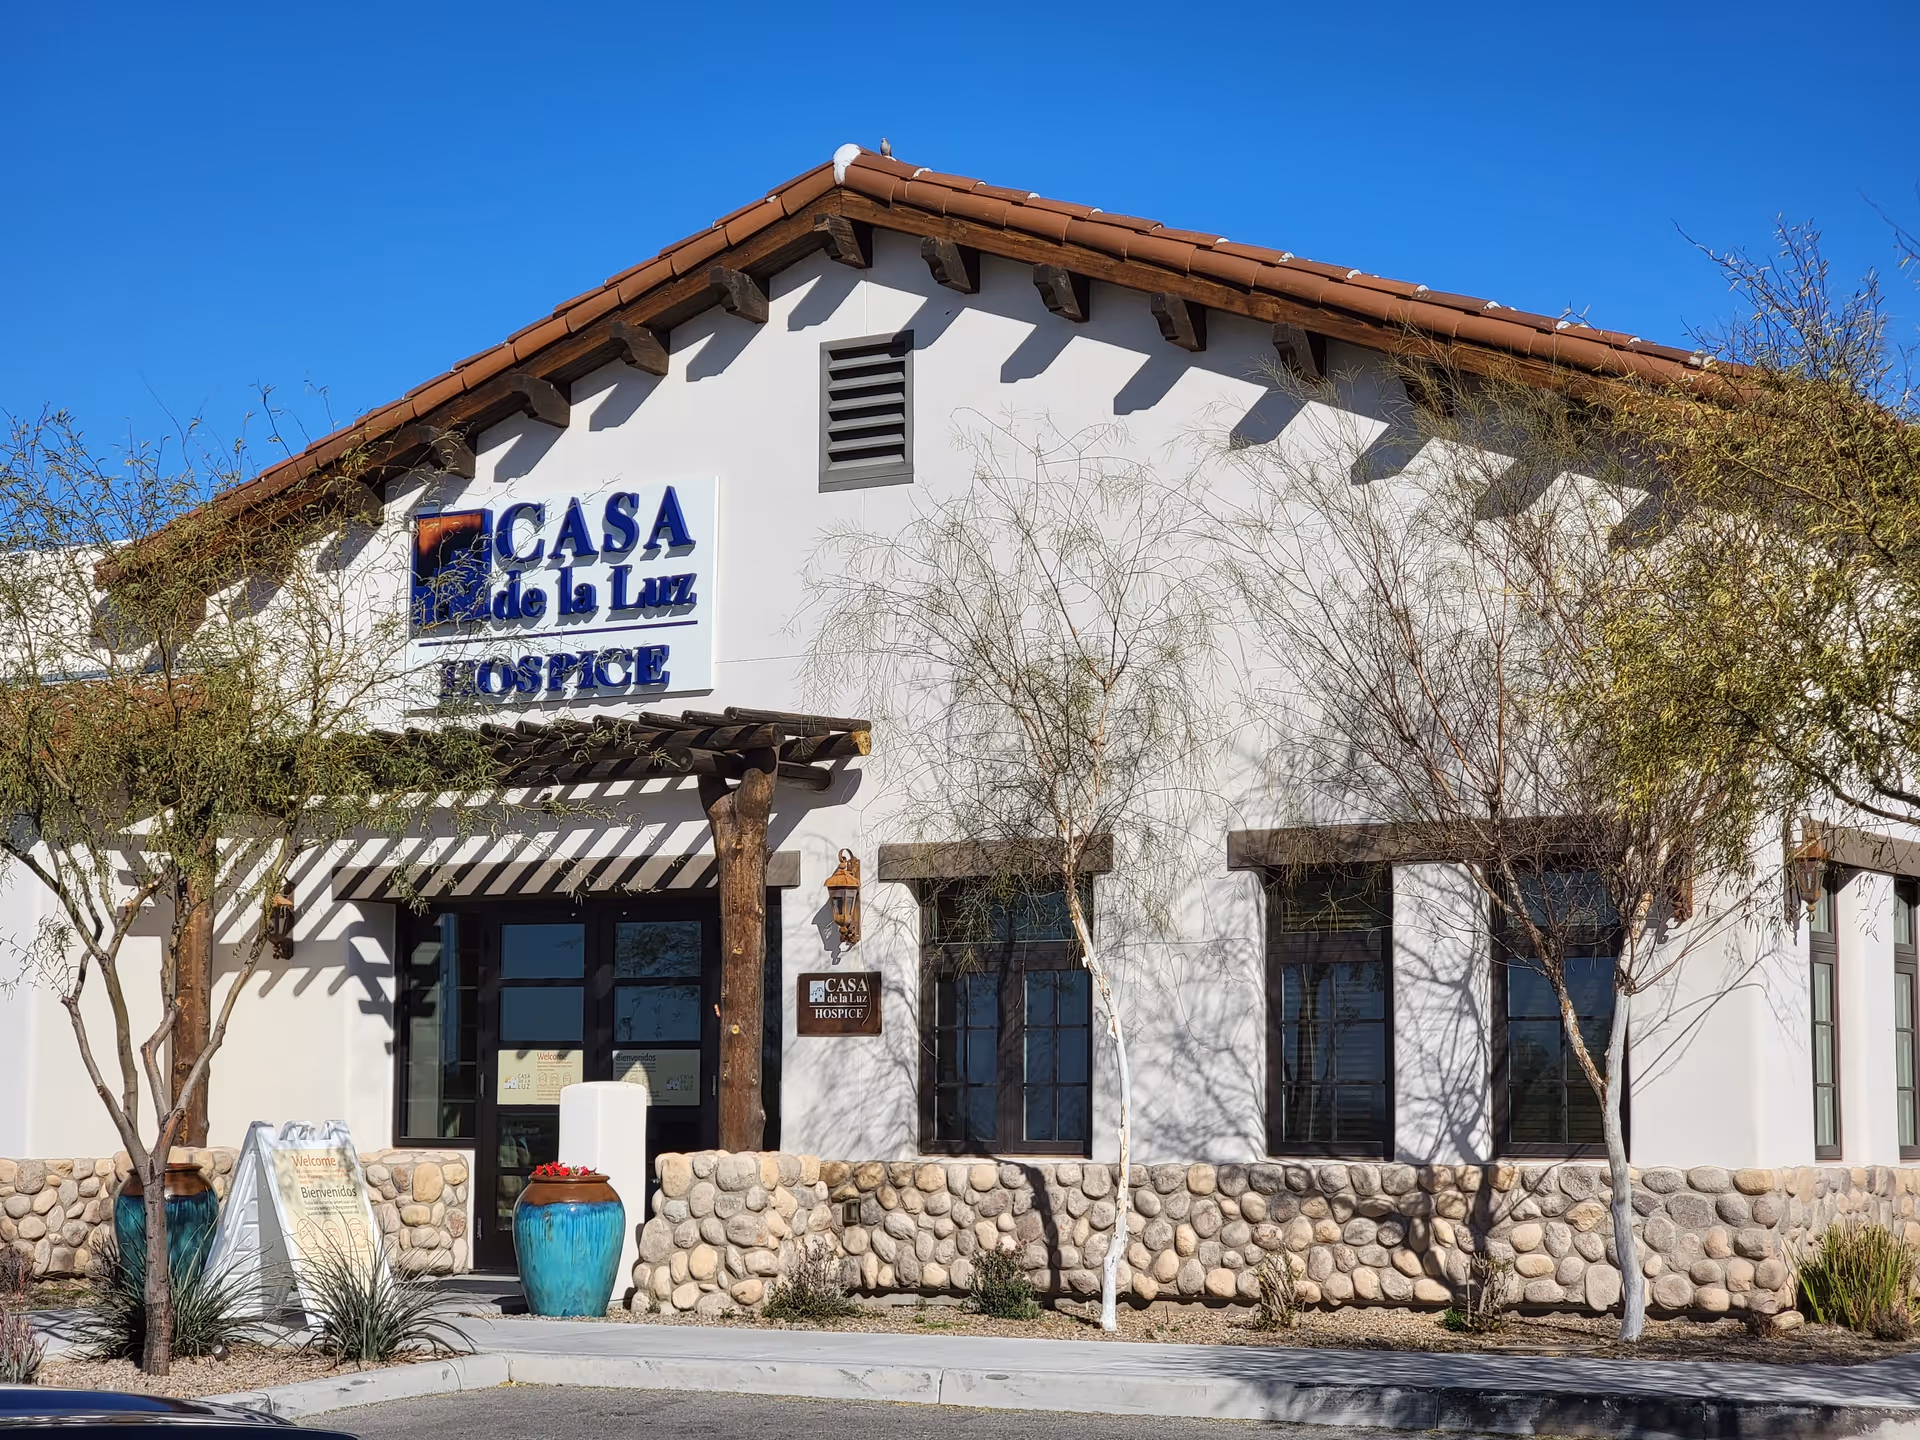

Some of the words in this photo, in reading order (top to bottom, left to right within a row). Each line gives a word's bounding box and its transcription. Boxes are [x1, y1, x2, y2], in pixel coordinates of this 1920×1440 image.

[495, 485, 697, 564] CASA
[492, 569, 548, 621] de
[558, 566, 597, 616] la
[609, 564, 698, 611] Luz
[825, 978, 868, 992] CASA
[827, 993, 838, 1003] de
[839, 993, 848, 1003] la
[849, 993, 868, 1003] Luz
[815, 1008, 864, 1019] HOSPICE
[536, 1052, 567, 1061] Welcome
[616, 1053, 657, 1062] Bienvenidos
[291, 1155, 337, 1167] Welcome
[300, 1185, 357, 1199] Bienvenidos
